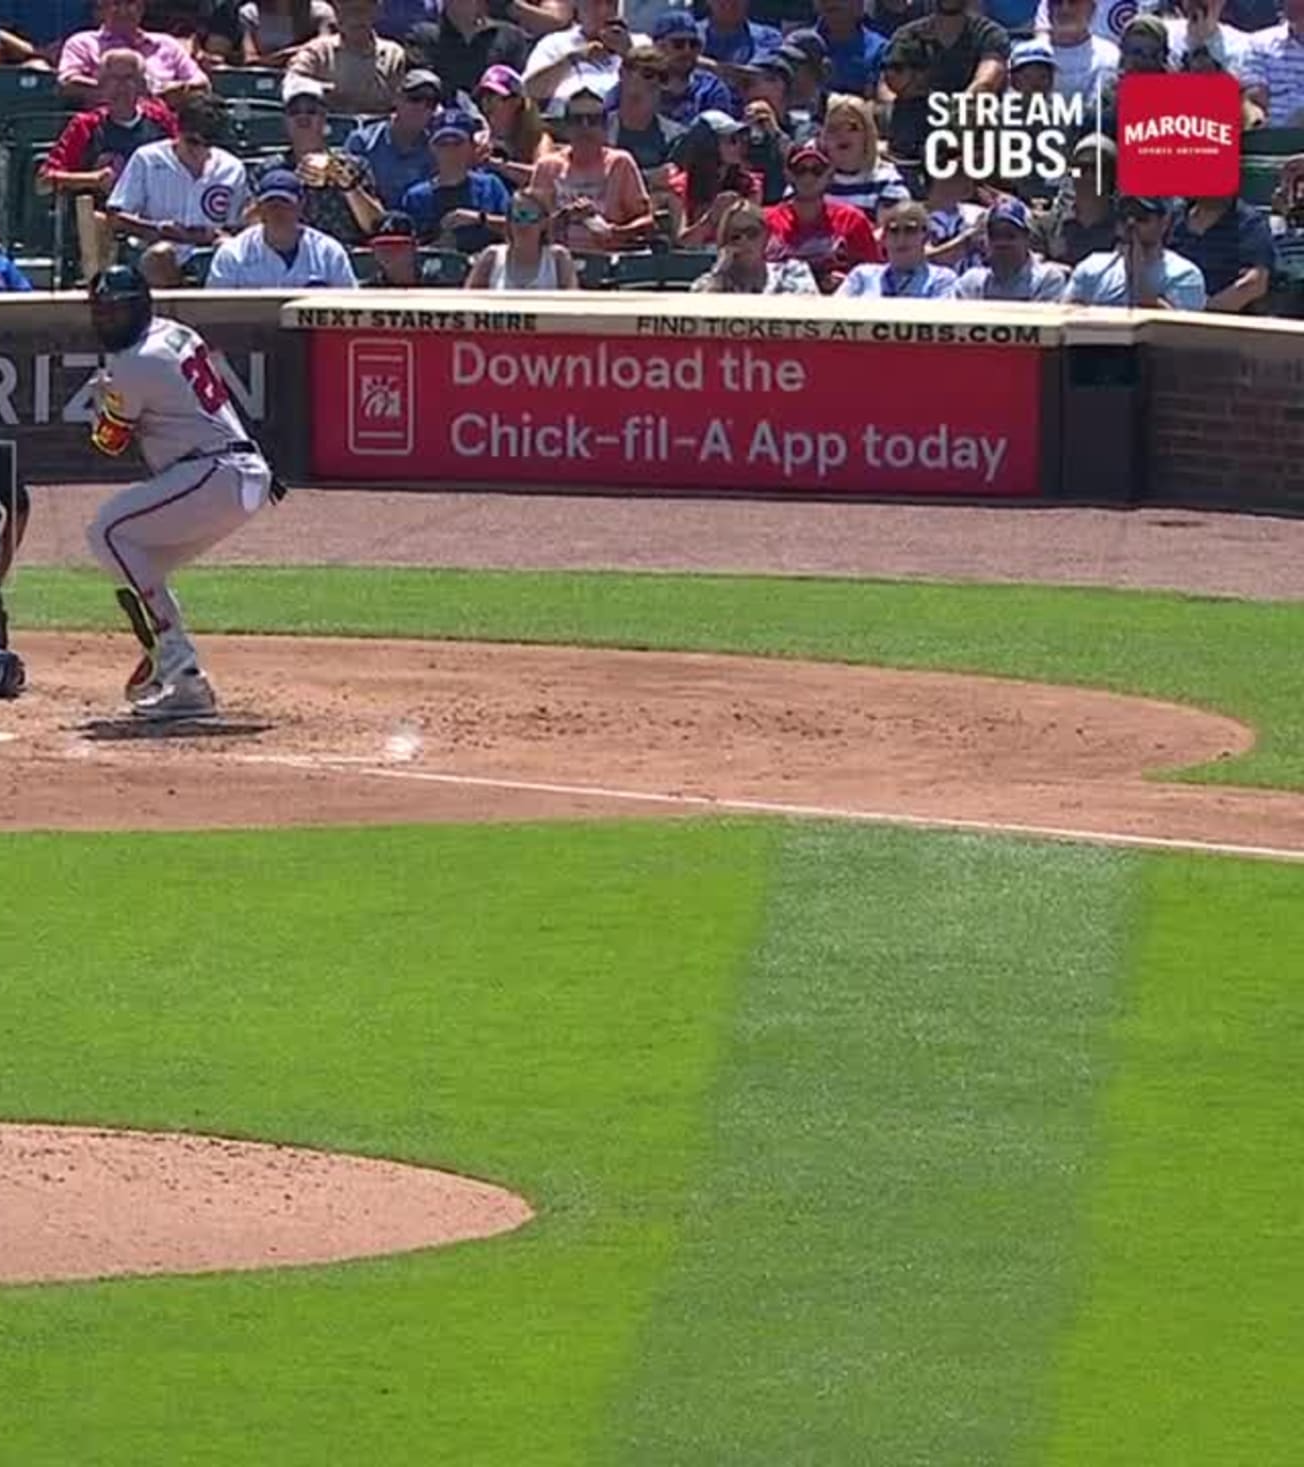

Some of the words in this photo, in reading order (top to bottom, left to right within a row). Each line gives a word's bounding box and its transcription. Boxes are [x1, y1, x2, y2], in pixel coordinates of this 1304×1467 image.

[297, 308, 363, 327] NEXT
[370, 310, 467, 330] STARTS
[474, 311, 538, 331] HERE
[636, 315, 696, 336] FIND
[705, 317, 821, 339] TICKETS
[829, 320, 863, 340] AT
[872, 323, 1040, 345] CUBS.COM
[452, 341, 704, 390] Download
[720, 348, 806, 392] the
[450, 413, 733, 463] Chick-fil-A
[747, 419, 848, 477] App
[861, 423, 1007, 483] today
